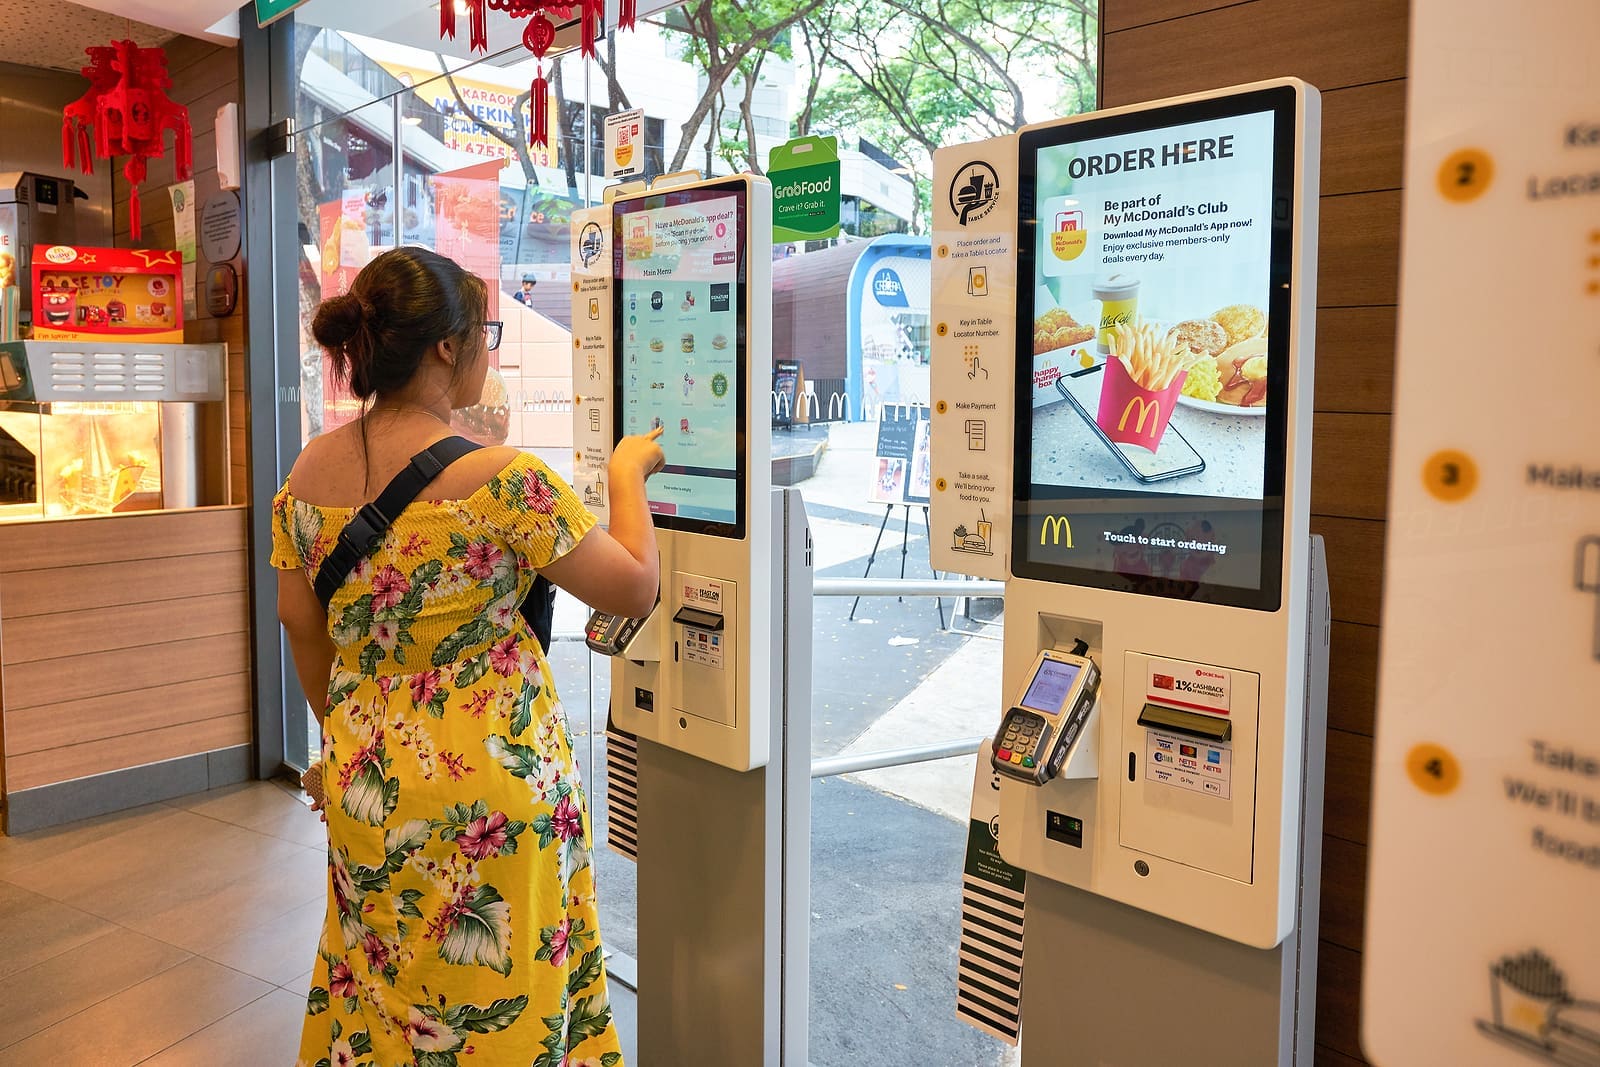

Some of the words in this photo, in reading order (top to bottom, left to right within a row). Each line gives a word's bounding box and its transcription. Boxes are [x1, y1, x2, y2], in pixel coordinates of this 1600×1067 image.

[462, 87, 516, 105] KARAOK
[511, 147, 549, 167] 313
[1068, 147, 1155, 179] ORDER
[1161, 135, 1234, 167] HERE
[1455, 162, 1475, 186] 2
[774, 176, 831, 199] GrabFood
[778, 205, 795, 213] Crave
[804, 201, 818, 210] Grab
[968, 214, 983, 222] TABLE
[984, 191, 1000, 215] SERVICE
[1104, 200, 1119, 212] Be
[1121, 197, 1146, 212] part
[1148, 194, 1162, 206] of
[673, 216, 704, 226] McDonald's
[716, 211, 734, 220] deal?
[1103, 214, 1121, 227] My
[1123, 205, 1195, 223] McDonald's
[1197, 201, 1228, 215] Club
[1103, 229, 1144, 240] Download
[1145, 228, 1158, 238] My
[1158, 223, 1209, 236] McDonald's
[1210, 222, 1228, 232] App
[1230, 218, 1253, 228] now!
[956, 240, 973, 248] Place
[973, 238, 989, 246] order
[989, 236, 1001, 244] and
[1102, 244, 1125, 253] Enjoy
[1126, 239, 1164, 250] exclusive
[1165, 233, 1231, 247] members-only
[969, 250, 984, 258] Table
[1102, 254, 1124, 264] deals
[1125, 253, 1148, 262] every
[1148, 252, 1165, 261] day.
[656, 268, 672, 276] Menu
[92, 274, 125, 288] TOY
[960, 319, 970, 327] Key
[976, 318, 992, 326] Table
[953, 330, 974, 338] Locator
[1034, 366, 1059, 378] happy
[1038, 380, 1053, 388] box
[971, 403, 996, 411] Payment
[958, 472, 972, 480] Take
[1440, 464, 1459, 486] 3
[1526, 464, 1600, 492] Make
[954, 482, 967, 490] We'll
[967, 483, 982, 492] bring
[959, 494, 972, 502] food
[1104, 532, 1136, 545] Touch
[1138, 535, 1149, 545] to
[1150, 537, 1176, 548] start
[1178, 540, 1226, 554] ordering
[1176, 680, 1192, 692] 1%
[1193, 682, 1224, 694] CASHBACK
[1179, 758, 1197, 766] NETS
[1530, 738, 1600, 777] Take
[1203, 764, 1221, 773] NETS
[1425, 758, 1443, 778] 4
[1502, 776, 1577, 818] We'll
[1531, 825, 1600, 868] food
